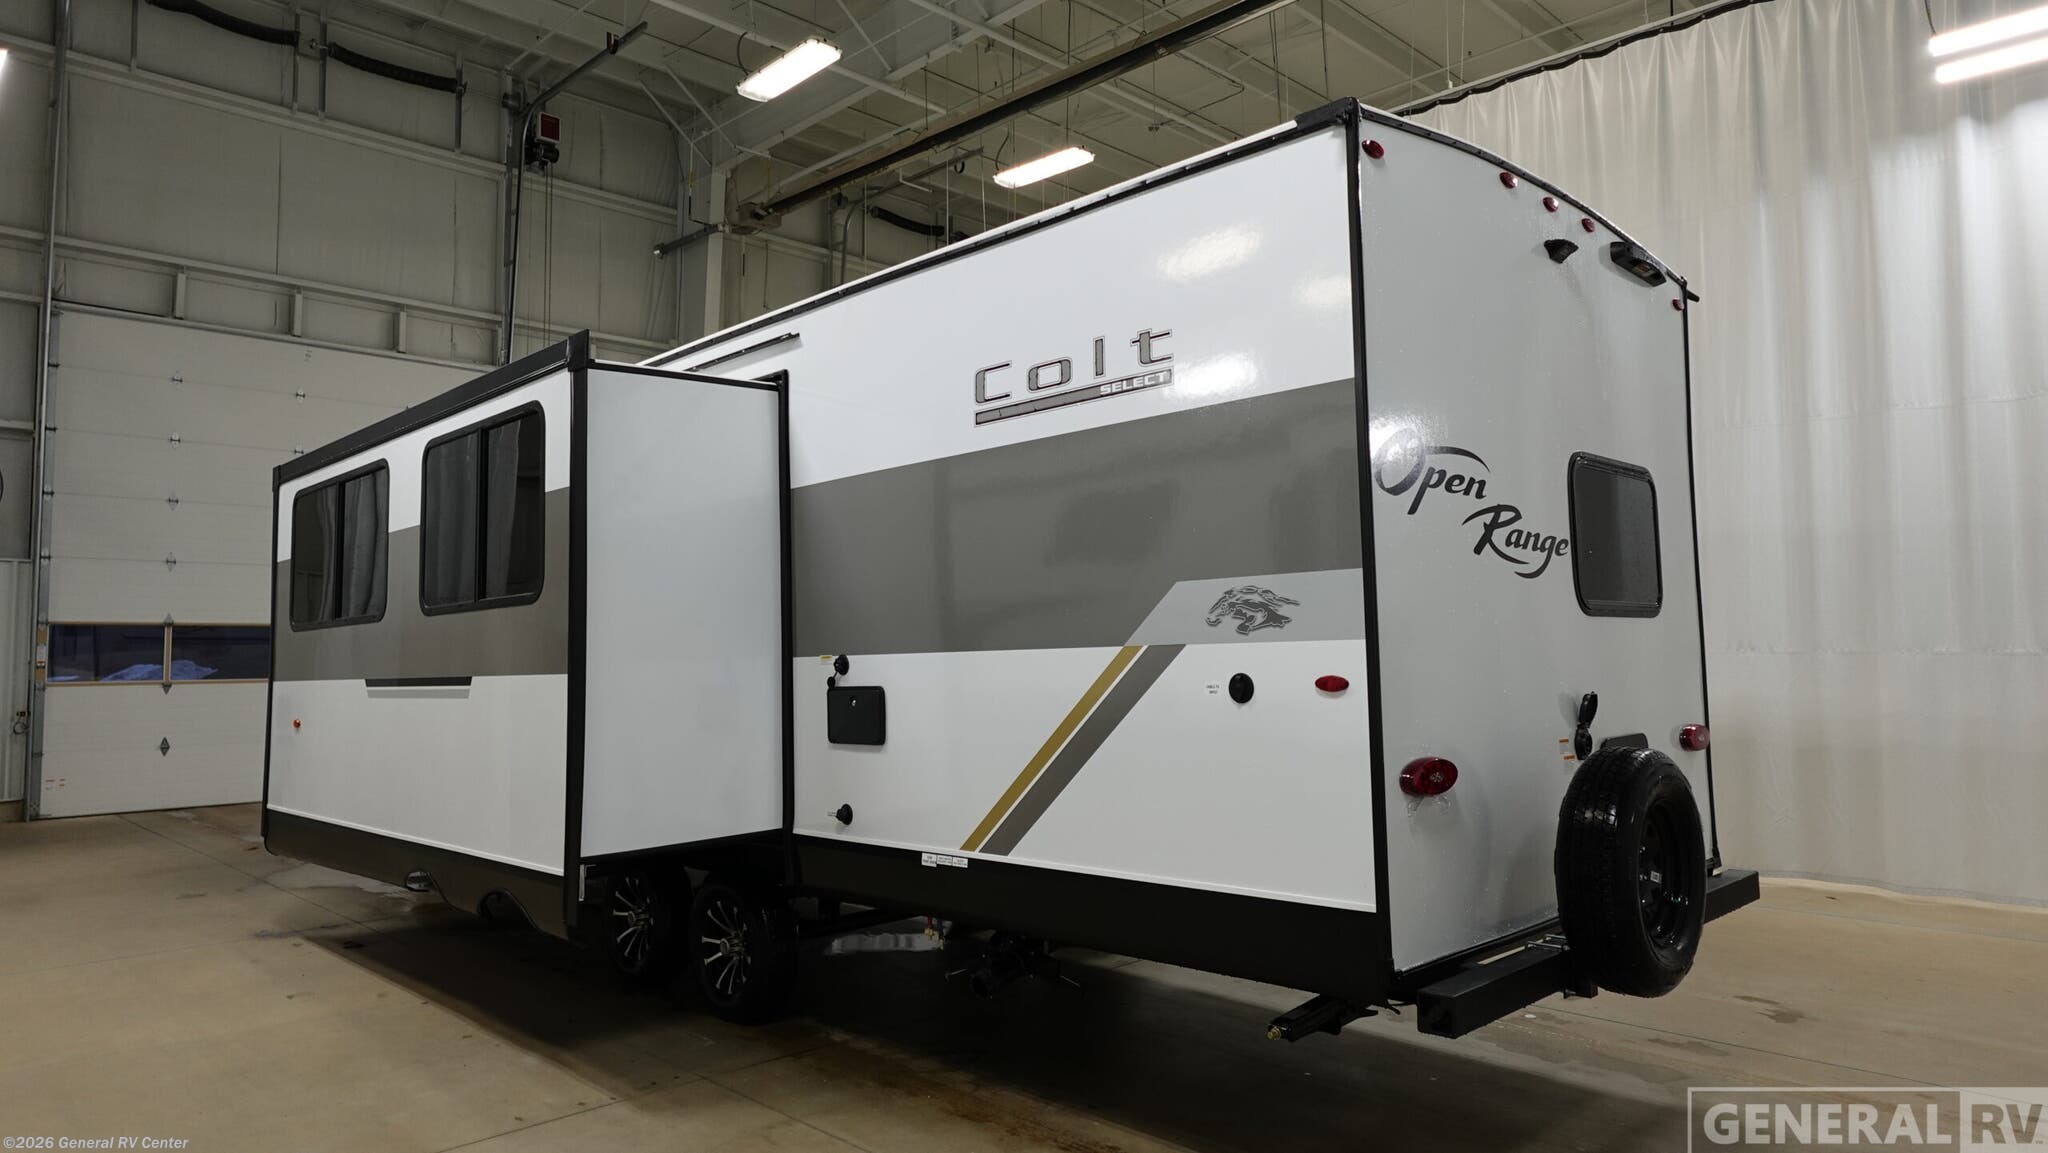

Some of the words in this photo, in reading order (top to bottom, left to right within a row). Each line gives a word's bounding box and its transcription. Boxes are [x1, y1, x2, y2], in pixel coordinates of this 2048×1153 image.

[975, 328, 1174, 404] Colt
[1099, 371, 1168, 396] SELECT
[1374, 427, 1490, 515] Open
[1462, 504, 1569, 579] Range
